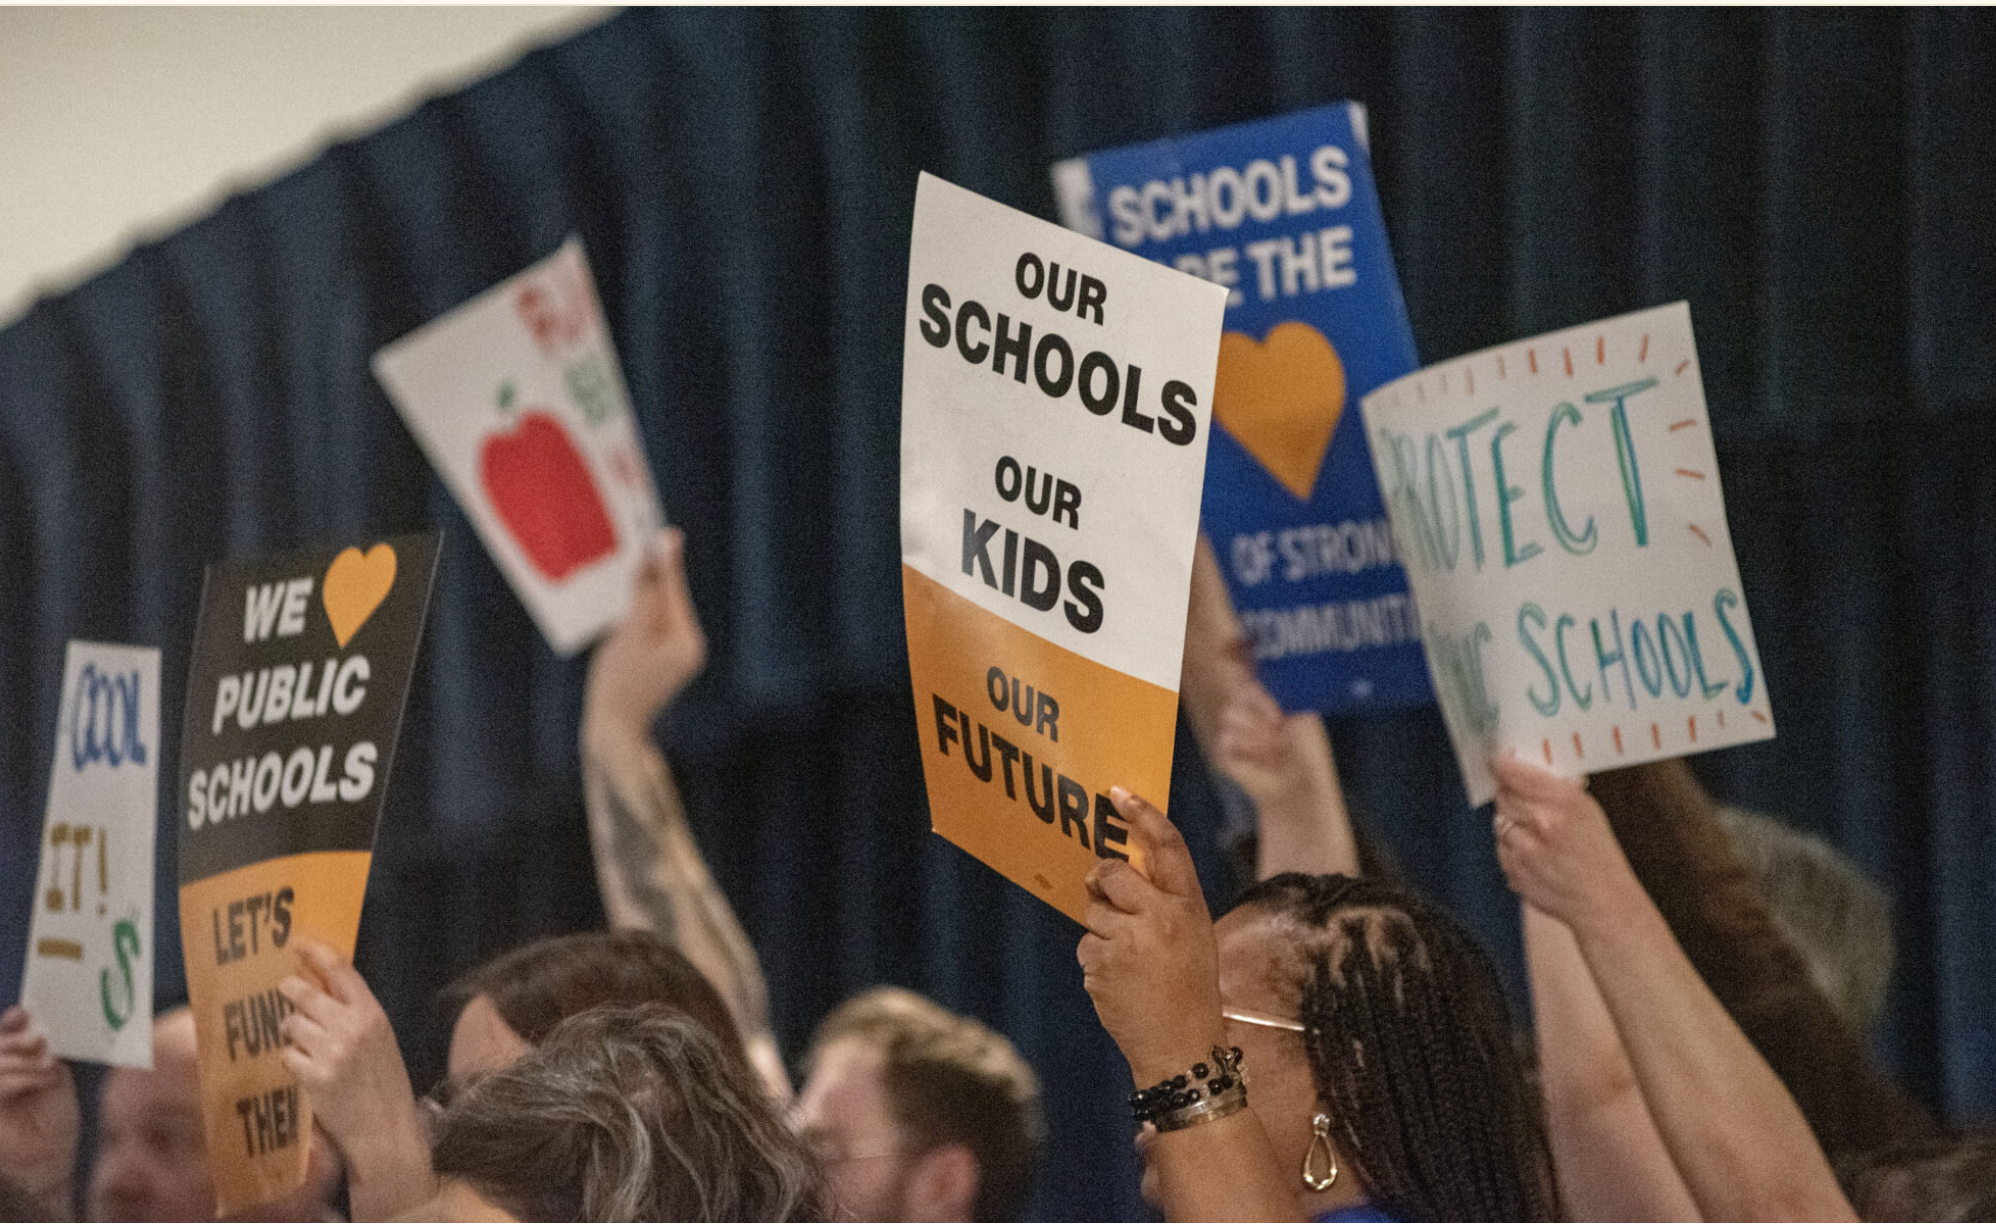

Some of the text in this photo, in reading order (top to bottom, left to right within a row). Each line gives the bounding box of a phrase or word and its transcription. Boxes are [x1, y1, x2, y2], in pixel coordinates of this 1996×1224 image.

[1108, 145, 1351, 247] SCHOOLS
[1015, 252, 1107, 326] OUR
[1246, 225, 1357, 300] THE
[920, 283, 1197, 446] SCHOOLS
[995, 456, 1082, 530] OUR
[244, 577, 313, 642] WE
[962, 508, 1105, 634] KIDS
[1518, 588, 1754, 717] SCHOOLS
[213, 654, 370, 735] PUBLIC
[987, 666, 1060, 743] OUR
[187, 743, 377, 830] SCHOOLS
[933, 693, 1130, 864] FUTURE
[213, 886, 294, 966] LET'S
